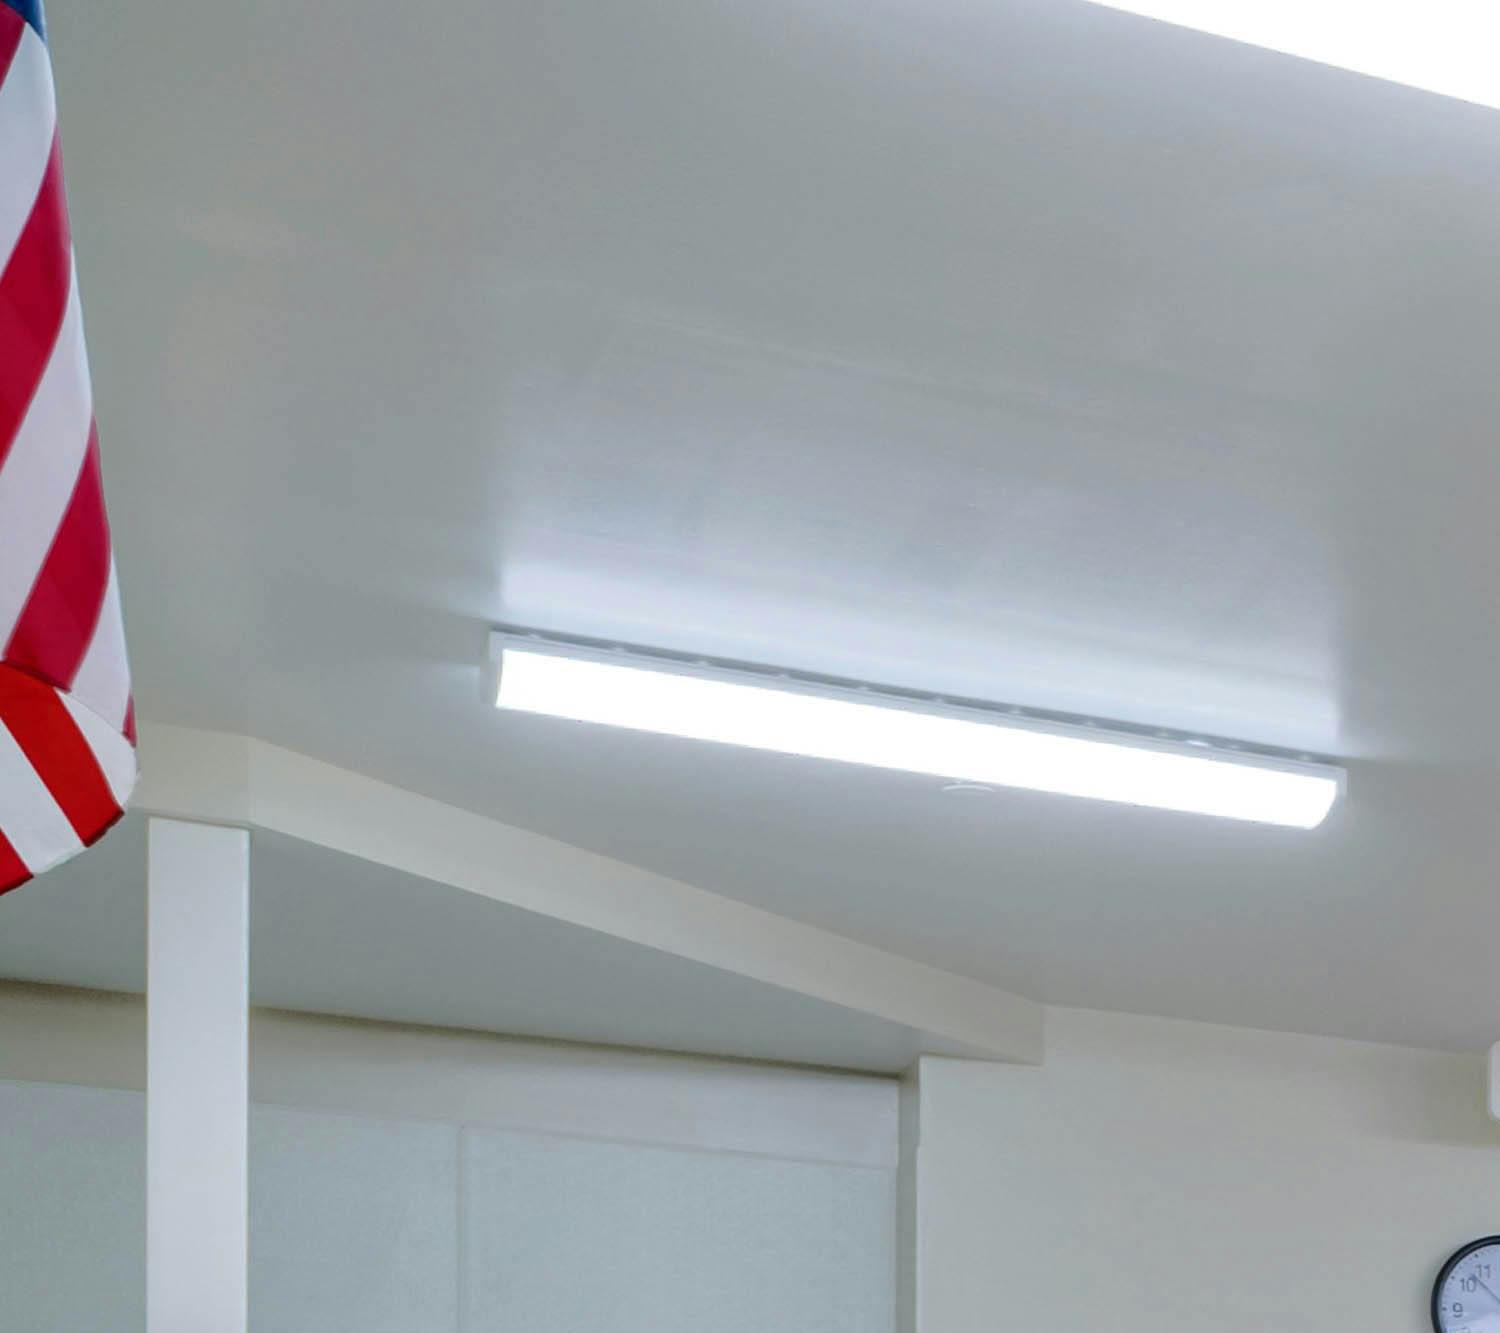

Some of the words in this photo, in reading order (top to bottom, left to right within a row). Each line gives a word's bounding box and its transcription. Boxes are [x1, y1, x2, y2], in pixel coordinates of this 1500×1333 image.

[1475, 1264, 1491, 1280] 11
[1460, 1276, 1477, 1293] 10
[1452, 1302, 1464, 1318] 9
